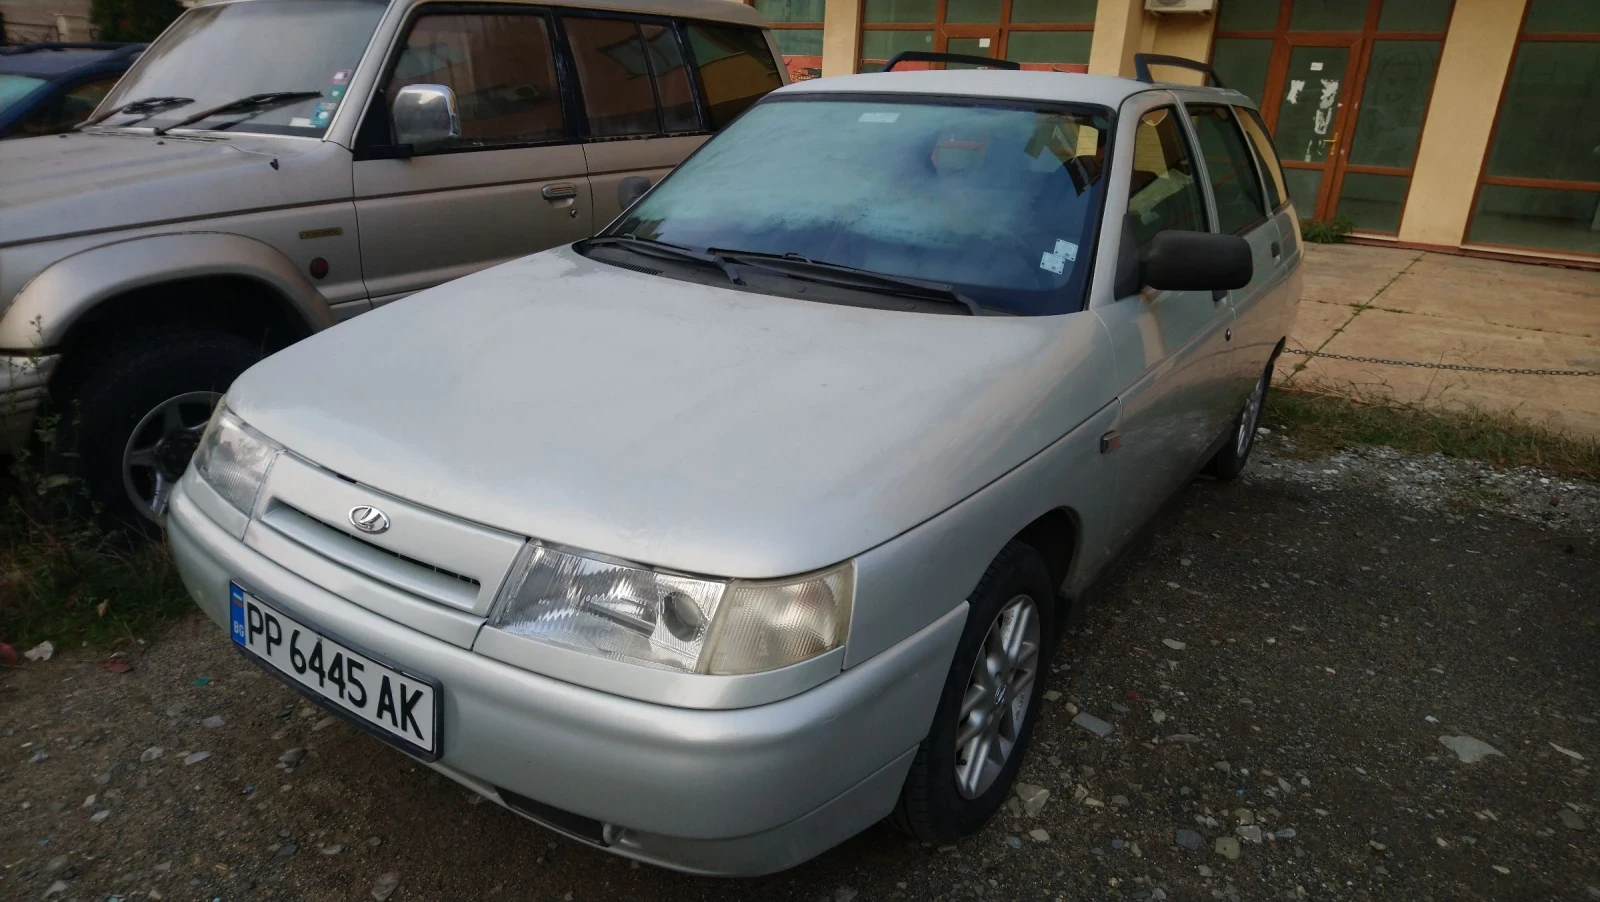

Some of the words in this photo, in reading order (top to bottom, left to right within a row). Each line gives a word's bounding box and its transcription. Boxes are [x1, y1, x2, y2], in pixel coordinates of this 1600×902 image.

[234, 620, 244, 637] BG
[247, 601, 282, 656] PP
[290, 629, 367, 708] 6445
[376, 675, 424, 740] AK
